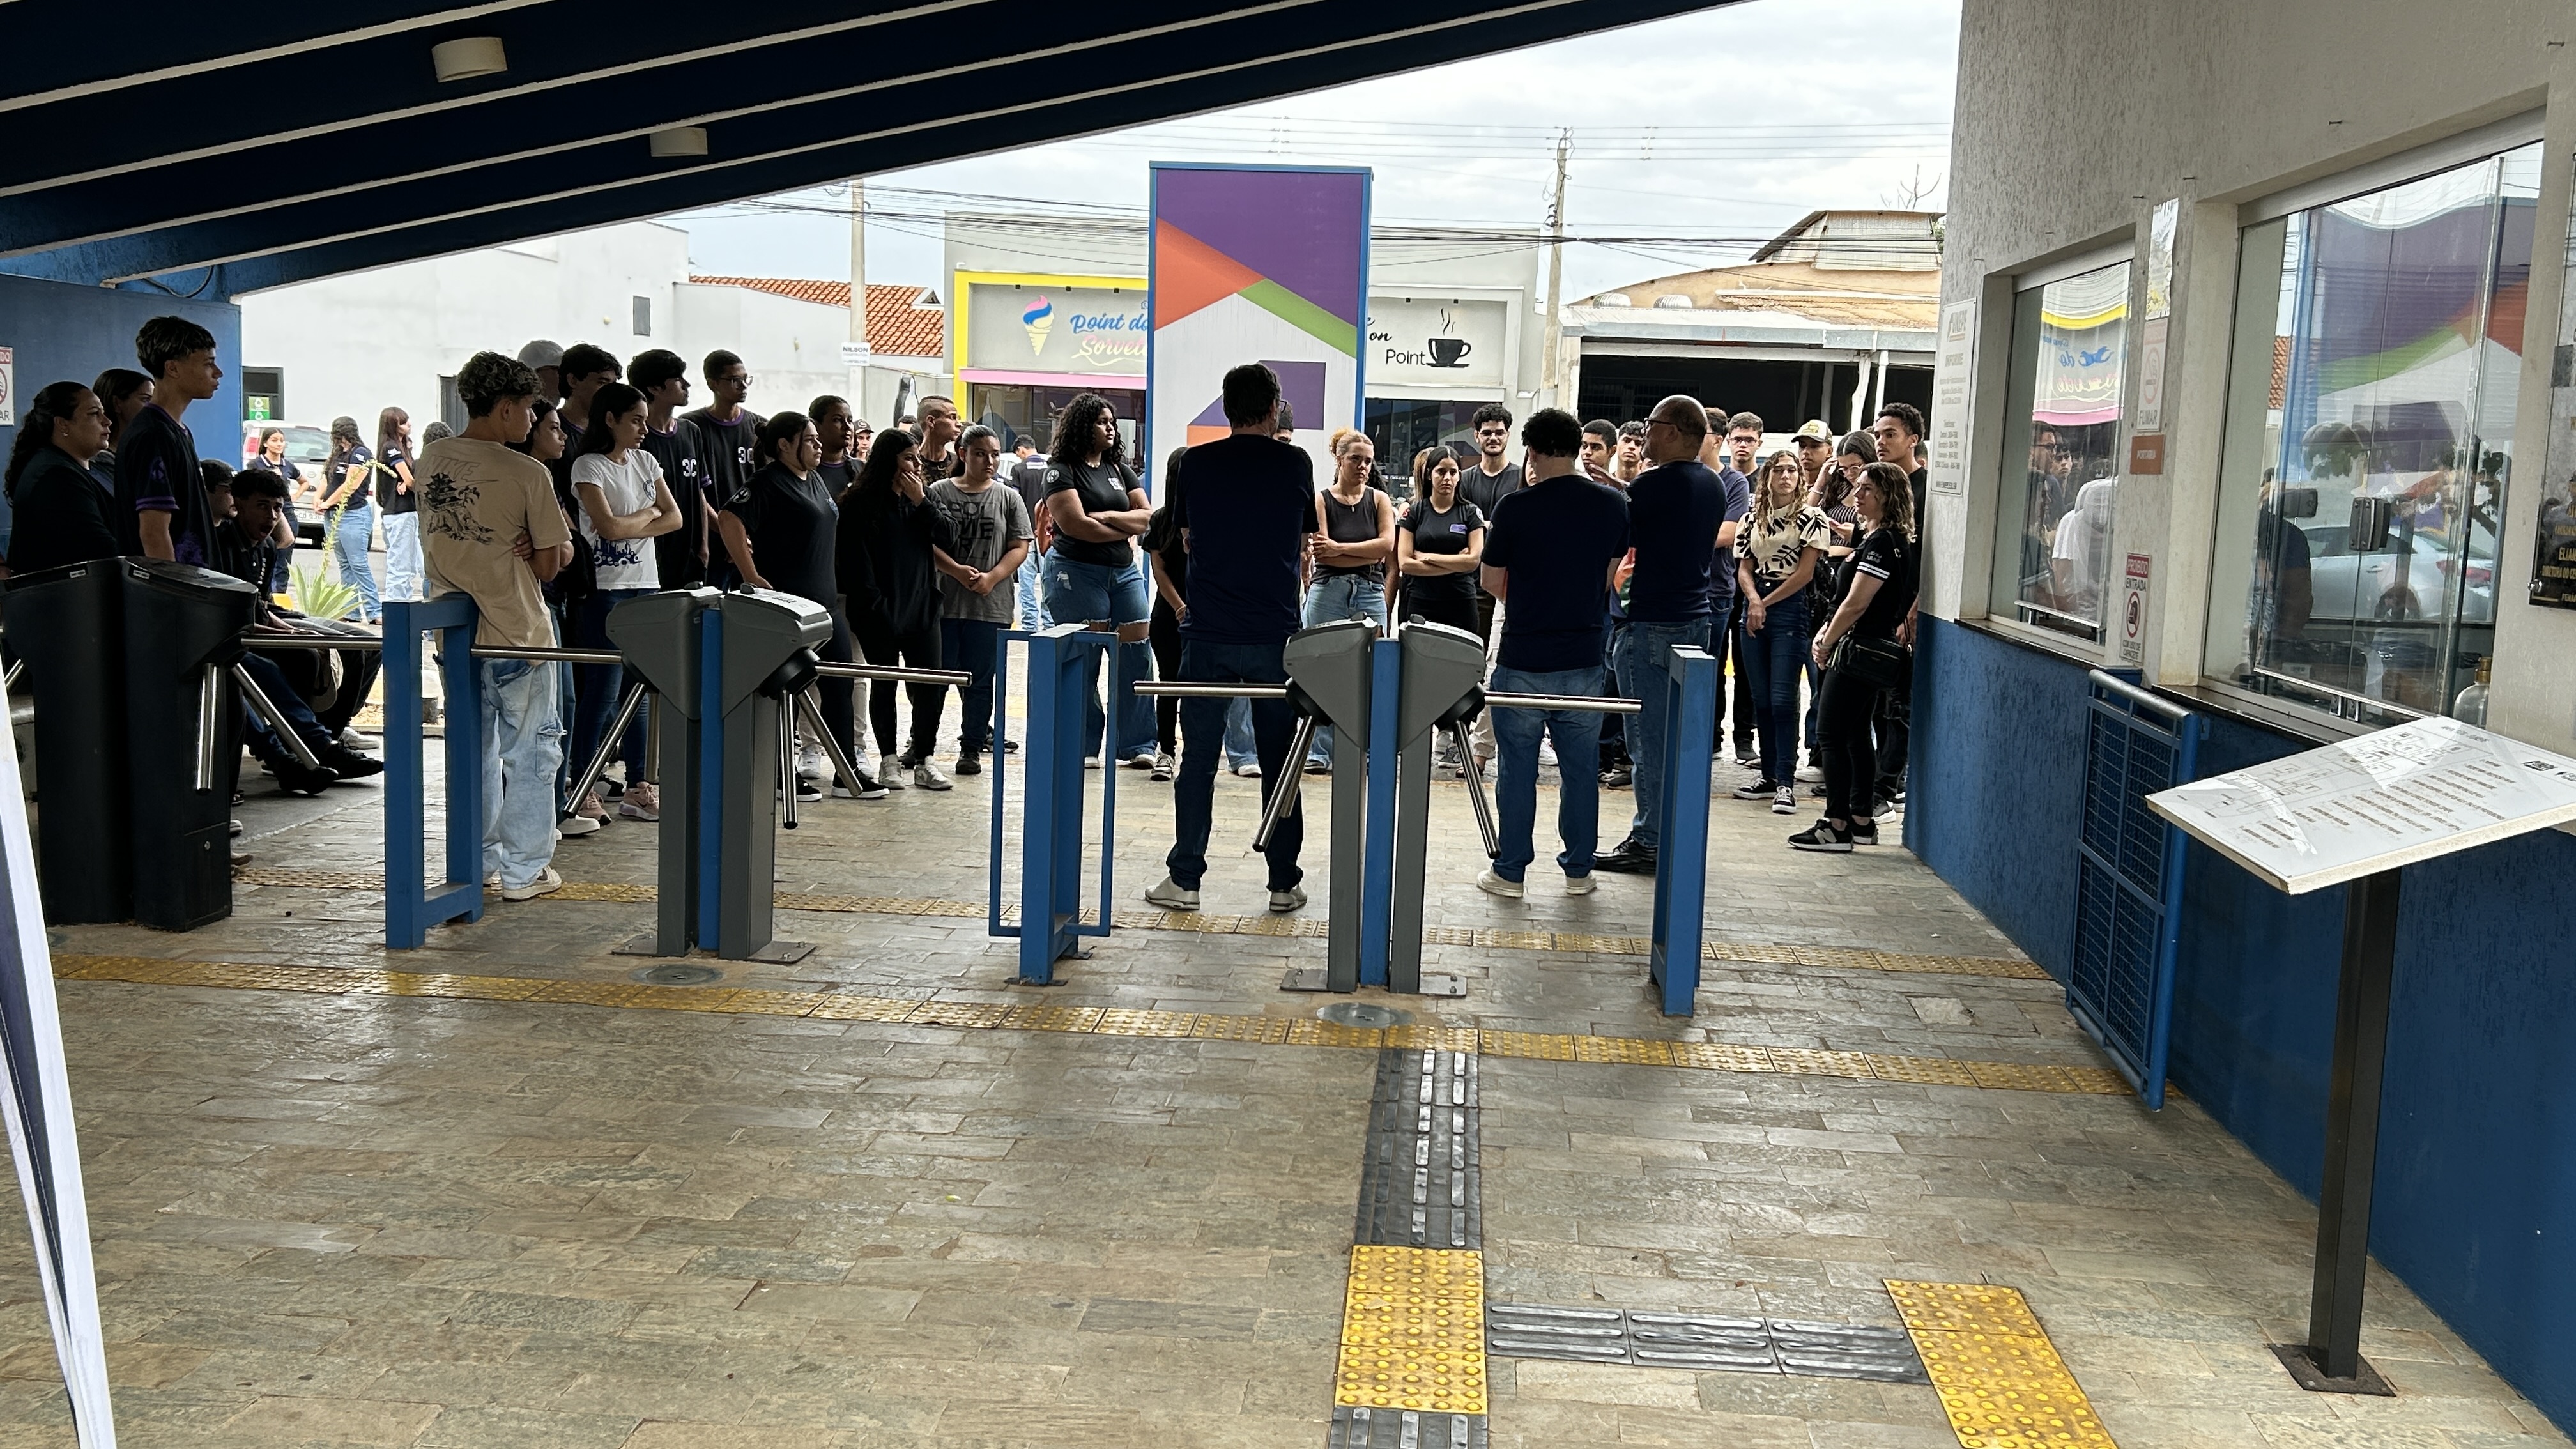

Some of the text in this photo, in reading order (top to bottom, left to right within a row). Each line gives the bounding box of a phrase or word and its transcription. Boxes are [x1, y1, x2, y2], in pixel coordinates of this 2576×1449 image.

[1070, 312, 1125, 334] Point
[1386, 349, 1426, 365] Point
[682, 459, 697, 477] 3C
